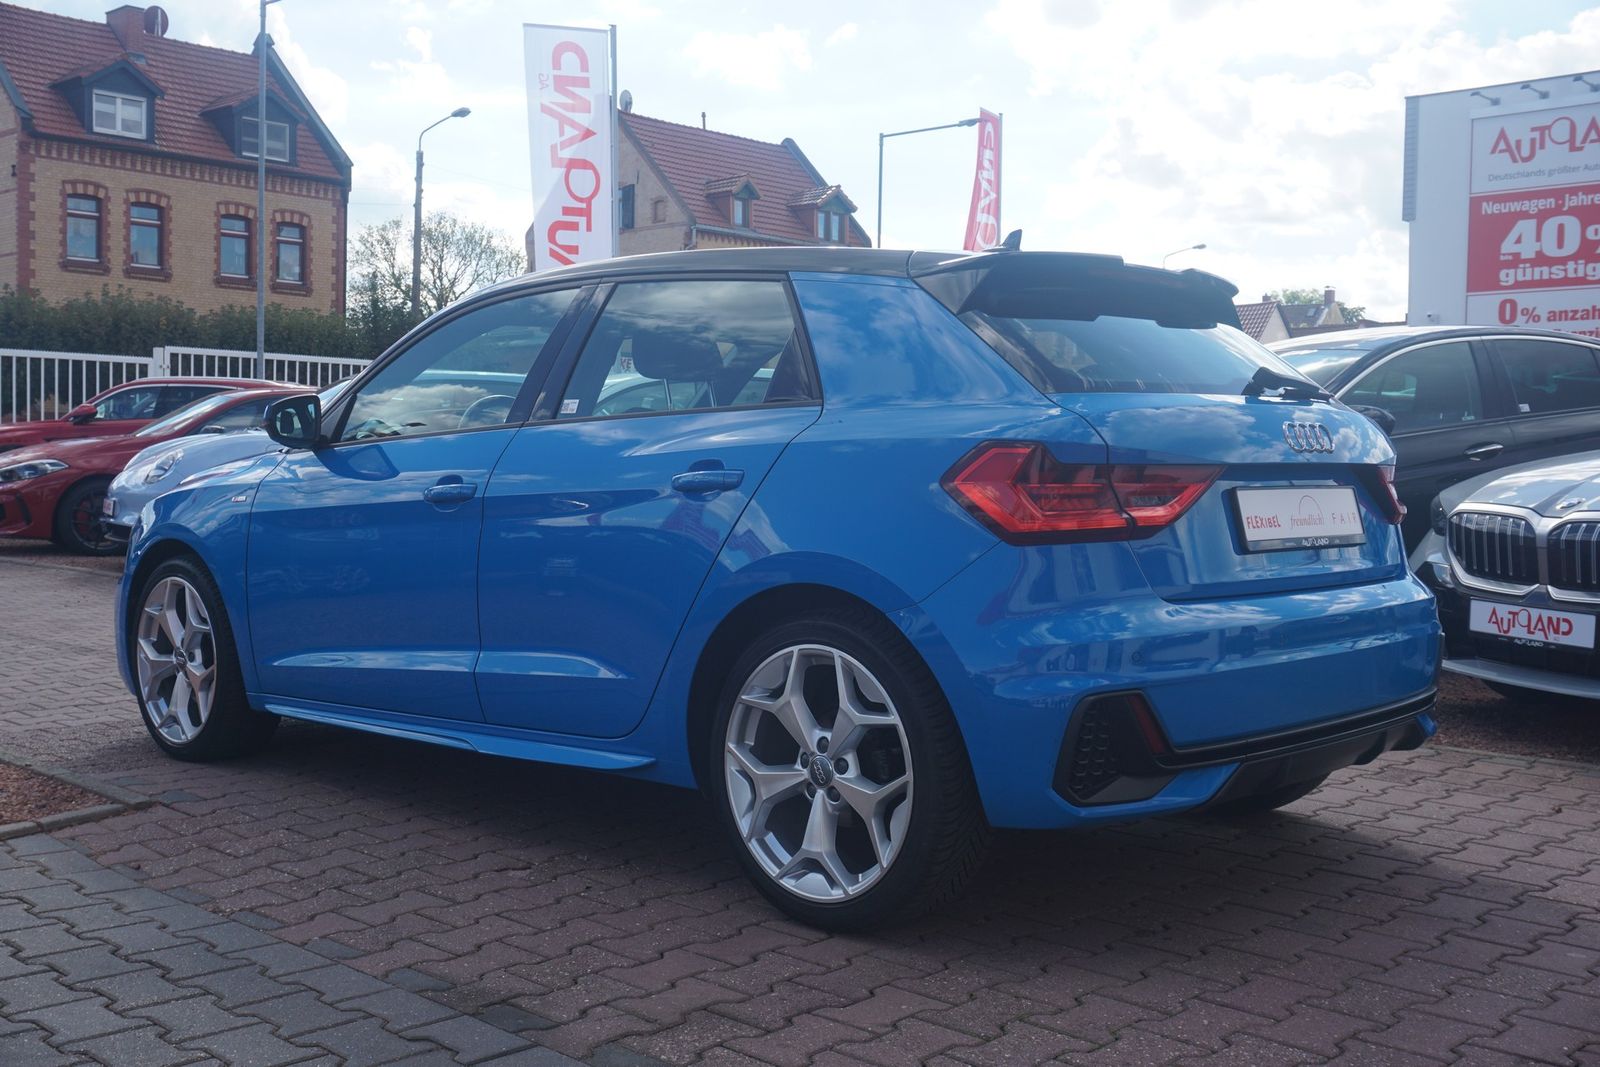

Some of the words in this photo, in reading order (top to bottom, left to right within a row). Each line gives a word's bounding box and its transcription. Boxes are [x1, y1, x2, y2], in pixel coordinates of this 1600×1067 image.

[1488, 169, 1546, 182] Deutschlands
[1548, 164, 1581, 178] größter
[1481, 197, 1556, 215] Neuwagen
[1488, 606, 1573, 640] AUTOLAND
